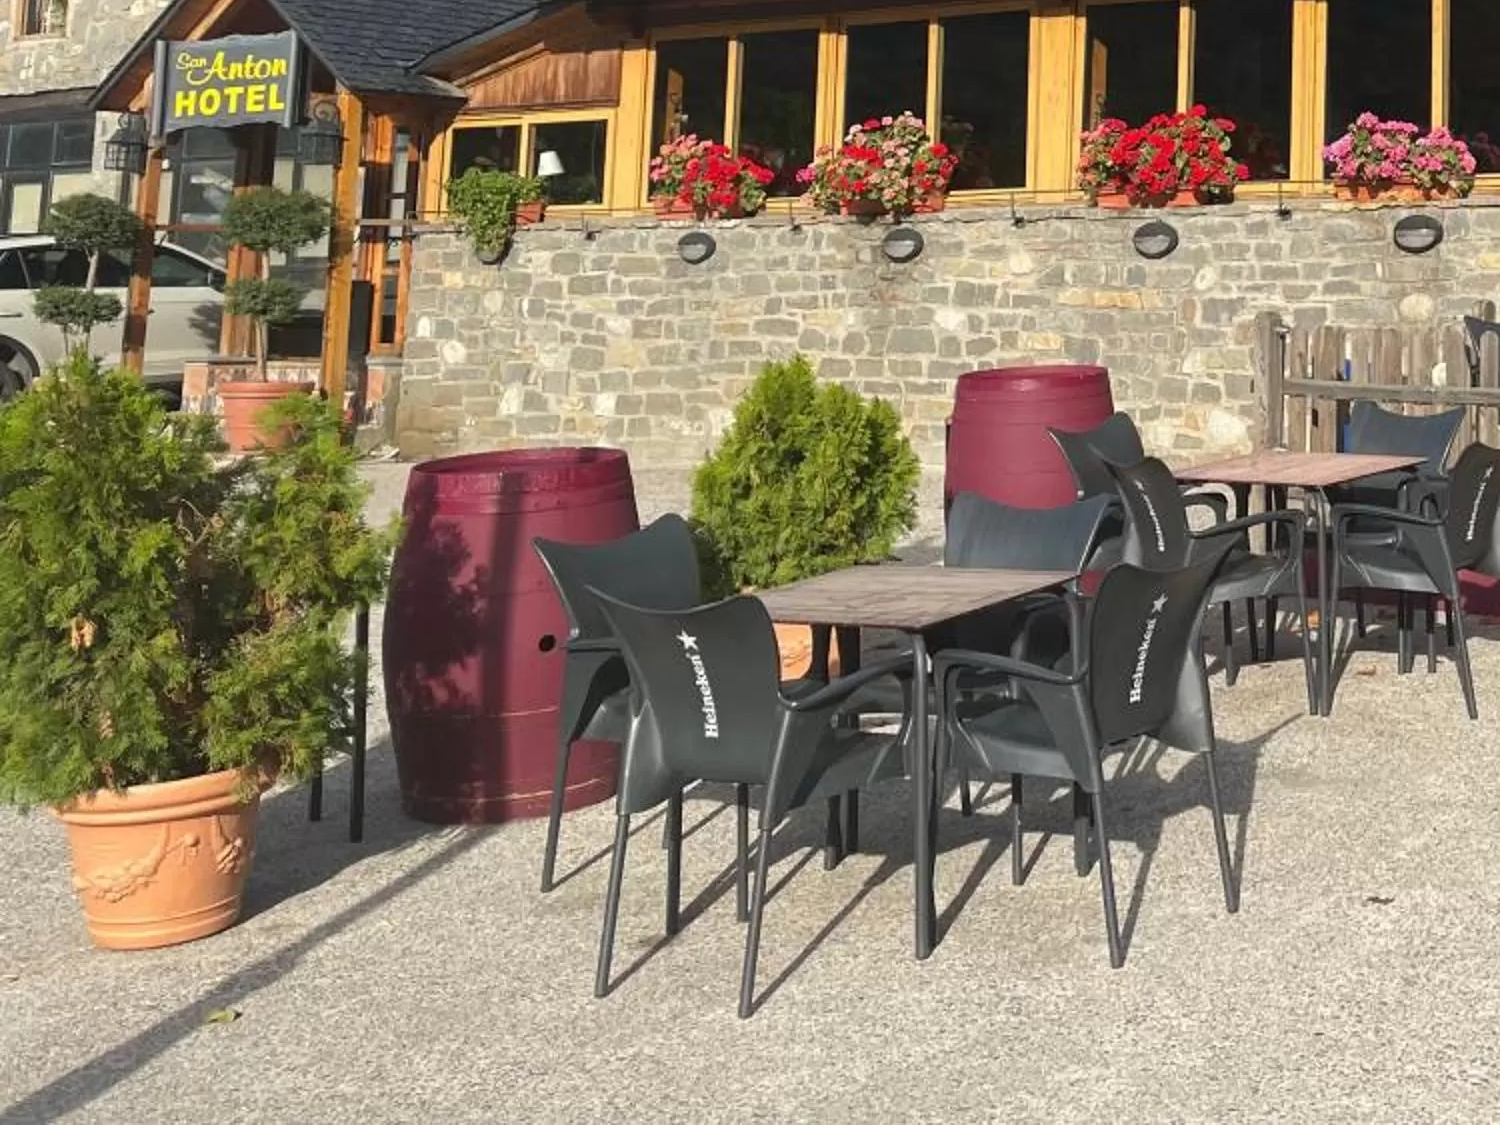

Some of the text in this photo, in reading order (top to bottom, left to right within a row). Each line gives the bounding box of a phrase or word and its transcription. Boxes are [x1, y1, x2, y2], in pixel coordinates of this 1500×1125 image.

[186, 50, 288, 86] Anton
[175, 83, 285, 118] HOTEL
[1129, 618, 1157, 704] Heineken
[690, 654, 719, 738] Heineken
